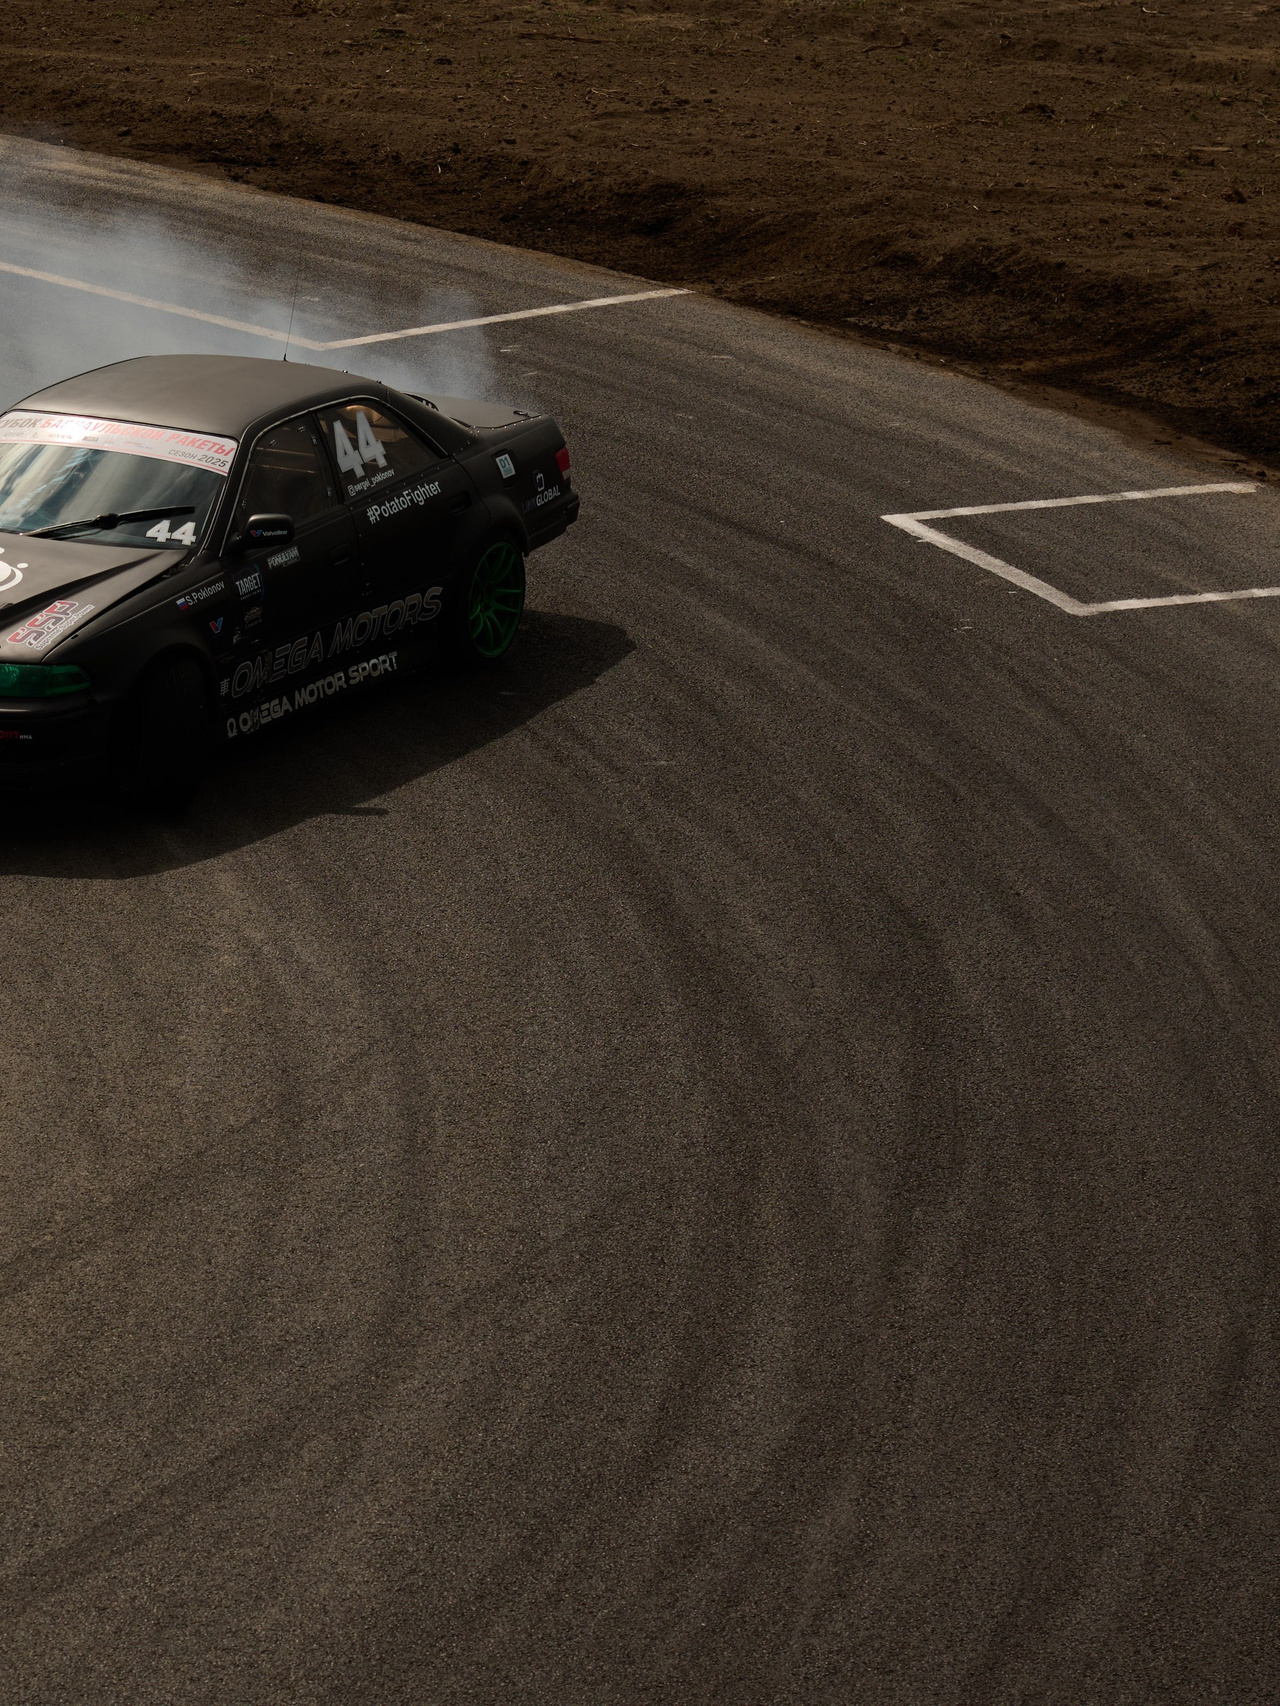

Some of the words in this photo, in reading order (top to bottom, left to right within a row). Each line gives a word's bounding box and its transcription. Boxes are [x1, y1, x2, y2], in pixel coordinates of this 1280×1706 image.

[165, 433, 236, 457] РАКЕТЫ
[333, 410, 388, 479] 44
[168, 449, 198, 460] СЕЗОН
[197, 454, 229, 468] 2025
[366, 481, 442, 525] #PotatoFighter
[145, 519, 197, 546] 44
[185, 581, 226, 606] S.Poklonov
[235, 572, 261, 596] TARGET
[232, 631, 324, 698] OMEGA
[327, 586, 443, 658] MOTORS
[239, 696, 293, 735] OMEGA
[294, 671, 347, 709] MOTOR
[348, 651, 398, 685] SPORT
